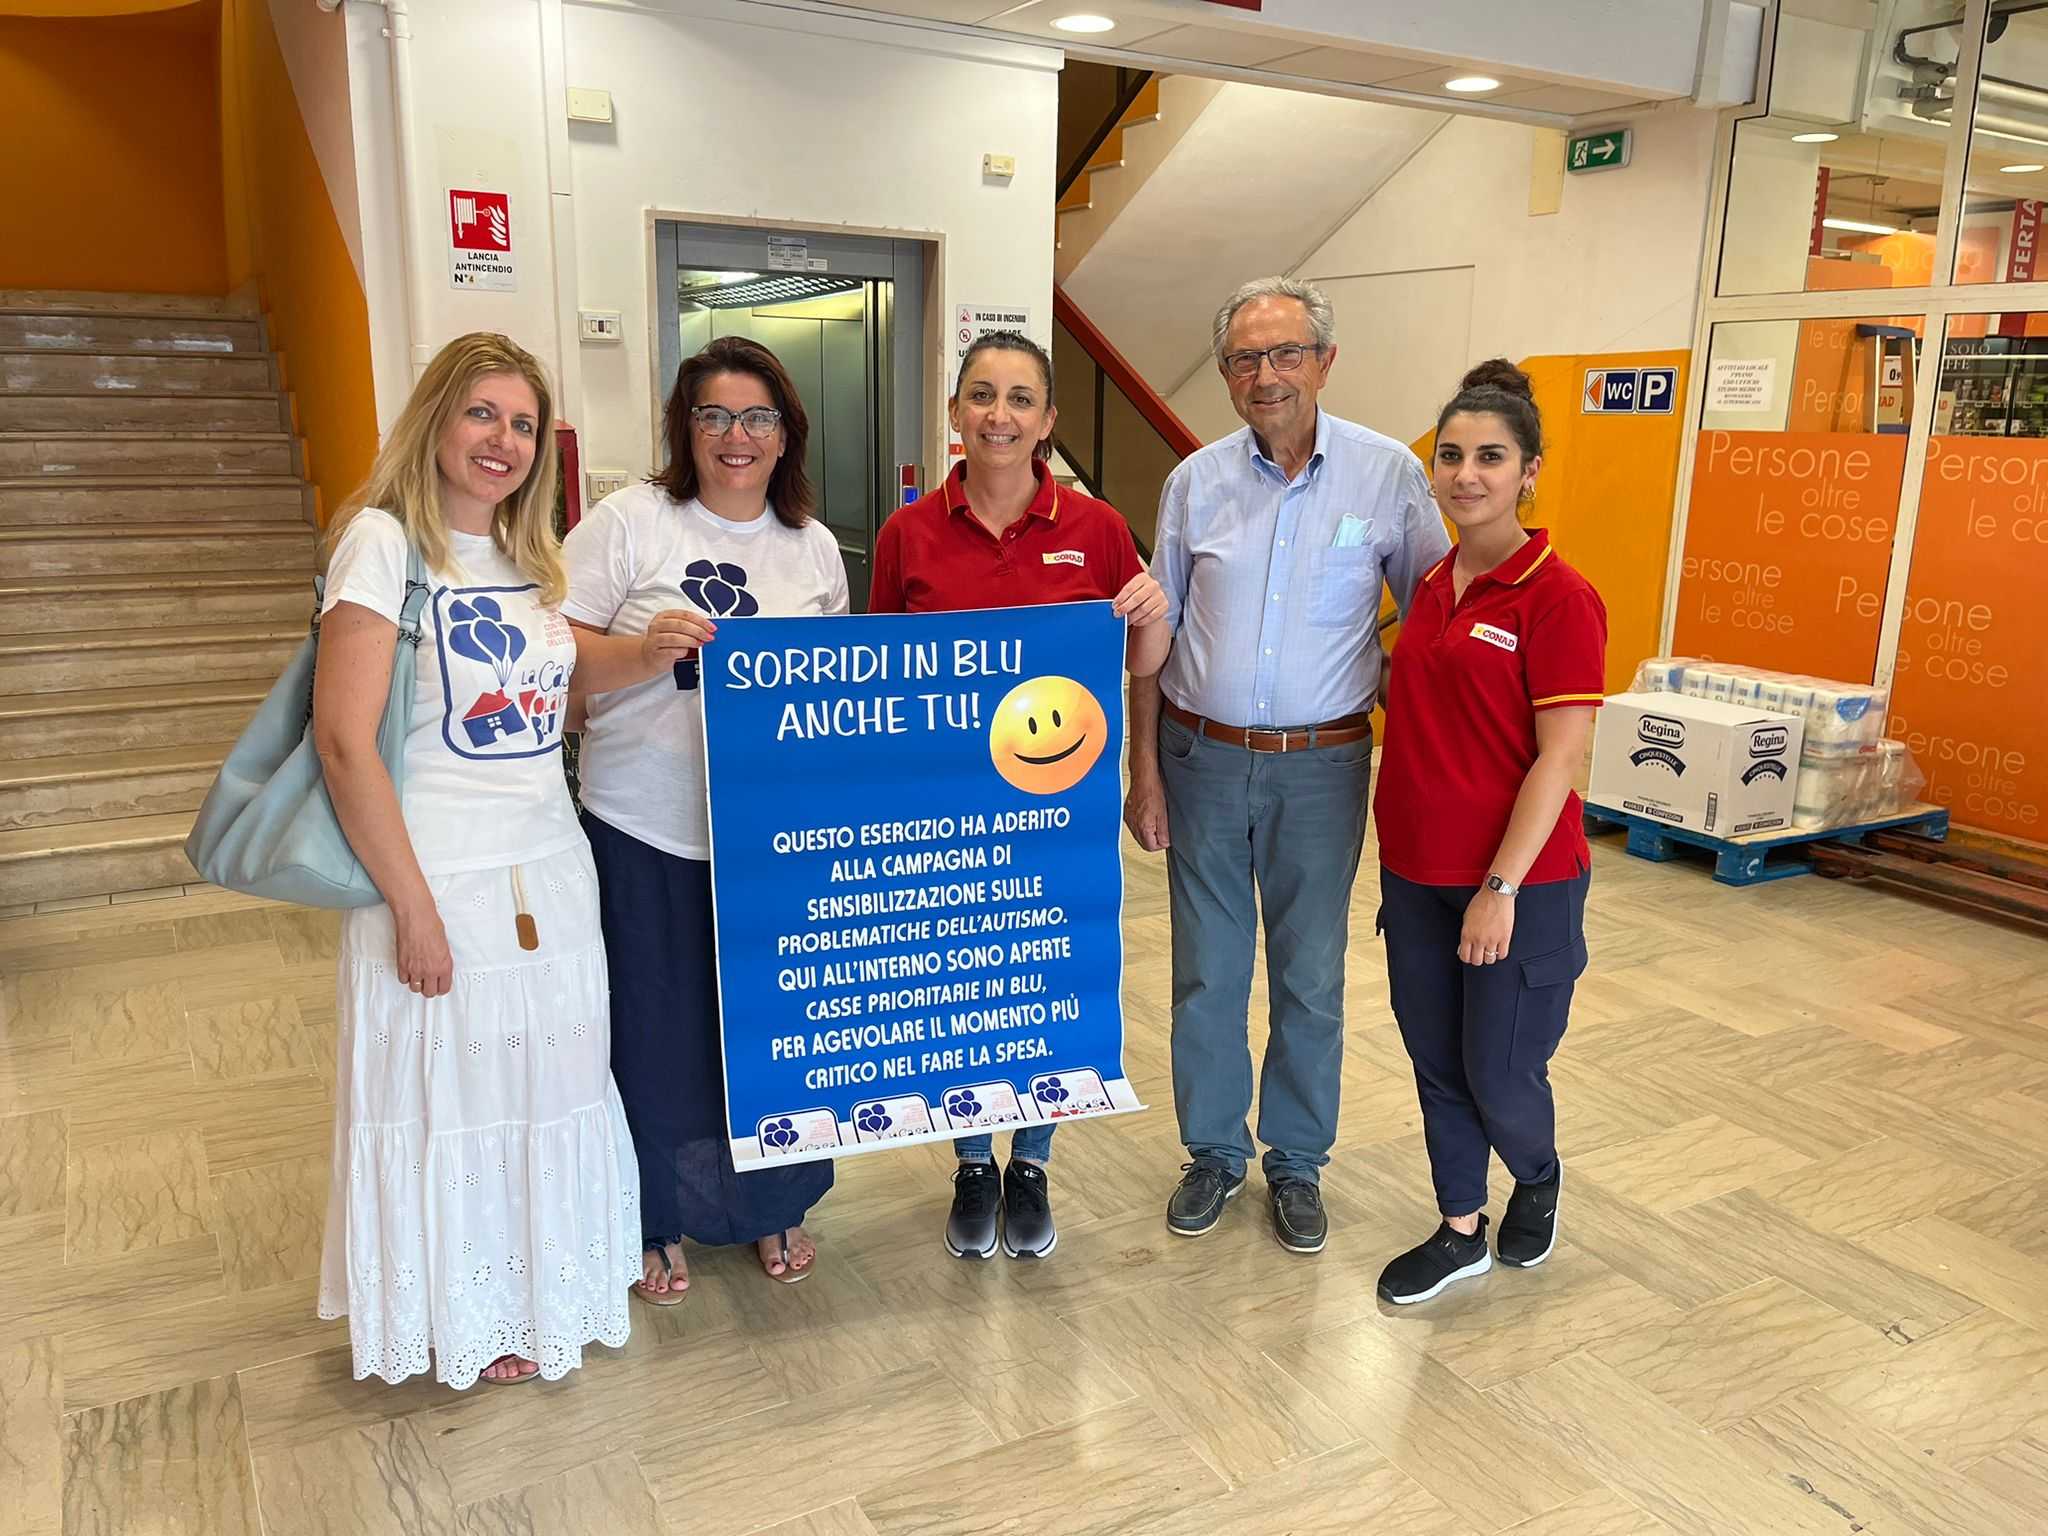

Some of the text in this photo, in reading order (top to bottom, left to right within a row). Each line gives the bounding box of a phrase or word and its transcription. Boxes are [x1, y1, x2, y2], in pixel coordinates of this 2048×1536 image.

[455, 263, 513, 274] ANTINCENDIO
[467, 252, 499, 262] LANCIA
[975, 312, 981, 321] IN
[982, 313, 995, 322] CASO
[997, 314, 1003, 322] DI
[1950, 343, 1990, 355] SOLO
[1607, 374, 1667, 408] WC P
[1708, 431, 1871, 480] Persone
[1801, 476, 1860, 510] oltre
[1756, 492, 1889, 543] le cose
[1967, 498, 1997, 538] le
[1054, 553, 1083, 563] CONAD
[1700, 592, 1794, 634] le cose
[1732, 585, 1775, 608] oltre
[1483, 630, 1515, 648] CONAD
[1927, 624, 1982, 656] oltre
[725, 639, 1022, 690] SORRIDI IN BLU
[1925, 655, 2009, 688] cose
[776, 692, 981, 741] ANCHE TU!
[1642, 720, 1681, 739] Regina
[1638, 751, 1678, 766] CINQUESTELLE
[1753, 733, 1785, 748] Regina
[1889, 716, 2025, 774] Persone
[1928, 769, 2039, 825] le cose
[1967, 767, 2017, 796] oltre
[772, 806, 1070, 855] QUESTO ESERCIZIO HA ADERITO
[830, 844, 1011, 883] ALLA CAMPAGNA DI
[807, 875, 1043, 921] SENSIBILIZZAZIONE SULLE
[777, 906, 1068, 956] PROBLEMATICHE DELL'AUTISMO.
[778, 936, 1072, 992] QUI ALL'INTERNO SONO APERTE
[806, 973, 1047, 1021] CASSE PRIORITARIE IN BLU,
[771, 992, 1081, 1061] PER AGEVOLARE IL MOMENTO PIÙ
[805, 1037, 1053, 1090] CRITICO NEL FARE LA SPESA.
